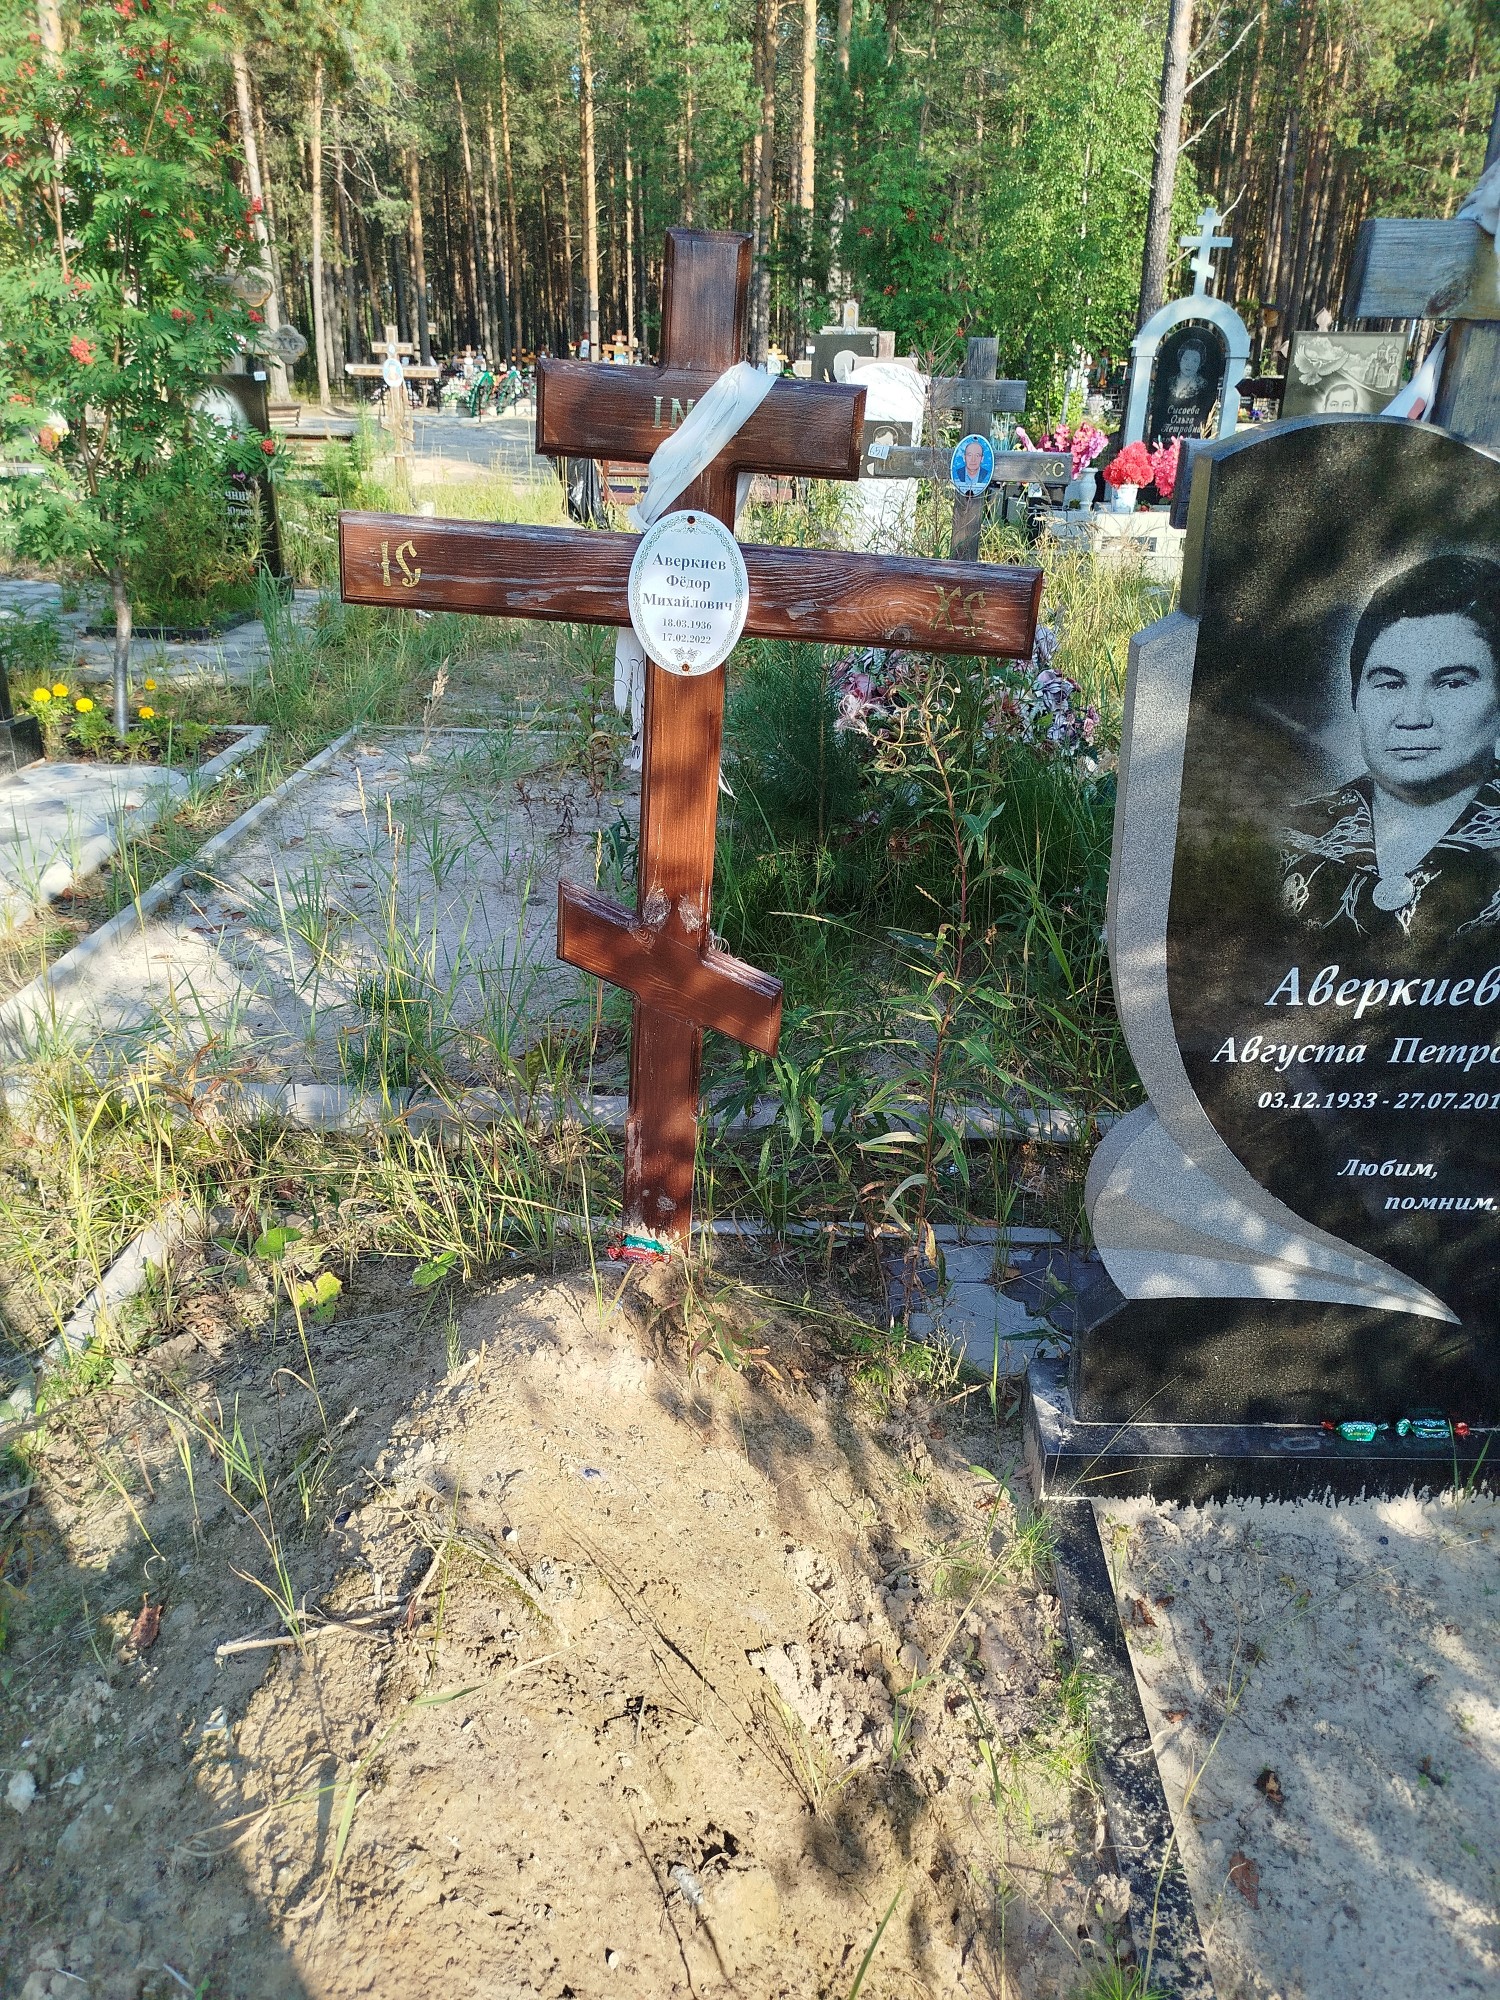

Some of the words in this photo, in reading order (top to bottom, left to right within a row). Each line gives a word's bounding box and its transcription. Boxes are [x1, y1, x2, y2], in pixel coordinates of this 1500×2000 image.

[1170, 414, 1195, 425] Ольга
[652, 552, 727, 571] Аверкиев
[666, 574, 711, 593] Фёдор
[642, 592, 733, 611] Михайлович
[662, 618, 712, 630] 18.03.1936
[661, 632, 712, 644] 17.02.2022
[1264, 964, 1500, 1020] Аверкиев
[1209, 1035, 1368, 1072] Августа
[1257, 1091, 1378, 1109] 03.12.1933
[1337, 1158, 1438, 1180] Любим,
[1384, 1196, 1498, 1211] помним.
